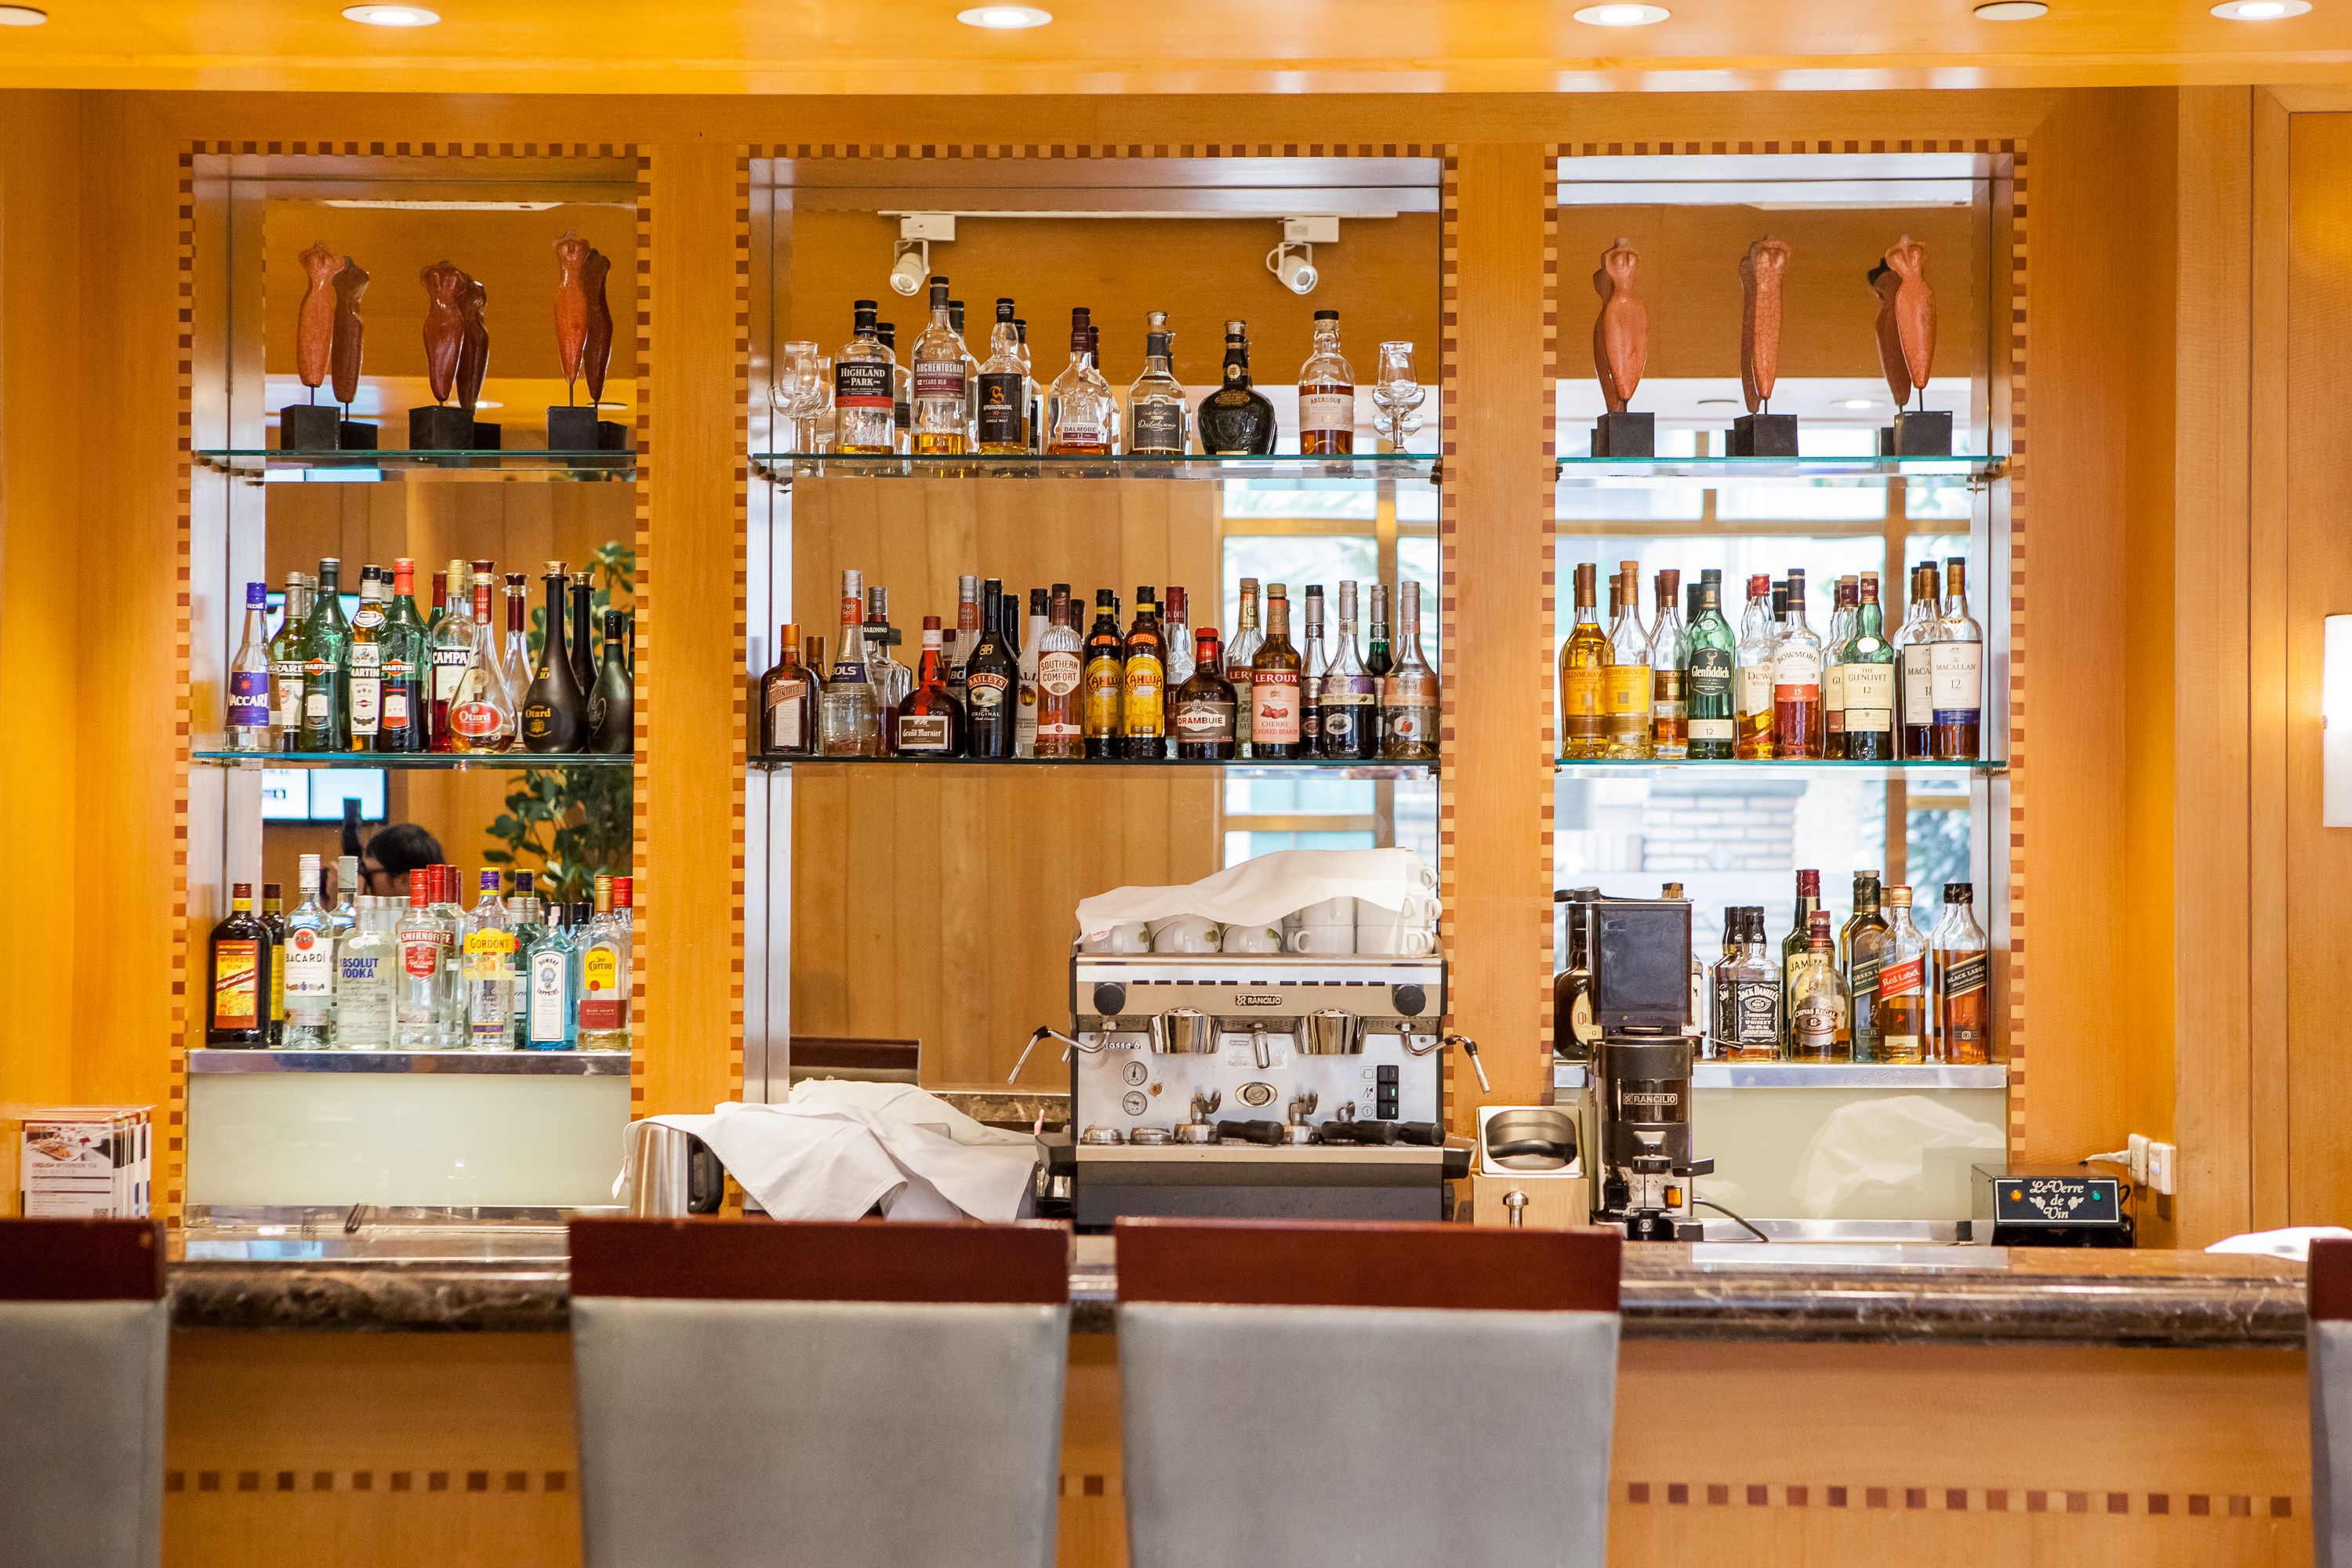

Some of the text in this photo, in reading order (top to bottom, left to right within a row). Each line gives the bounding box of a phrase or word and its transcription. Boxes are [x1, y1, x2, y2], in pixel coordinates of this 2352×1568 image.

[841, 368, 885, 377] HIGHLAND
[916, 363, 964, 373] AUCHENTOSHAN
[851, 377, 874, 387] PARK
[1138, 419, 1176, 428] Dalwhinnie
[1777, 652, 1817, 664] BOWMORE
[1041, 660, 1078, 670] SOUTHERN
[351, 668, 379, 677] ARTIN
[1043, 673, 1076, 681] COMFORT
[1691, 666, 1730, 677] Glenfiddich
[968, 676, 1005, 688] BAILEYS
[1124, 671, 1163, 690] KAHLÚA
[1255, 674, 1298, 684] LEROUX
[1951, 679, 1962, 689] 12
[771, 684, 804, 703] COINTREAU
[459, 710, 491, 721] Otard
[525, 708, 551, 717] Otard
[1178, 717, 1223, 725] DRAMBUIE
[285, 950, 326, 962] BACARDÍ
[589, 961, 612, 971] Cuervo
[1853, 971, 1873, 982] GREEN
[1947, 972, 1966, 984] BLACK
[1967, 965, 1986, 976] LABEL
[1882, 975, 1898, 986] Red
[1738, 989, 1755, 1001] JACK
[1795, 1008, 1836, 1018] CHIVAS REGAL
[2029, 1180, 2085, 1193] Le Verre
[2050, 1194, 2063, 1207] de
[2043, 1207, 2069, 1220] Vin
